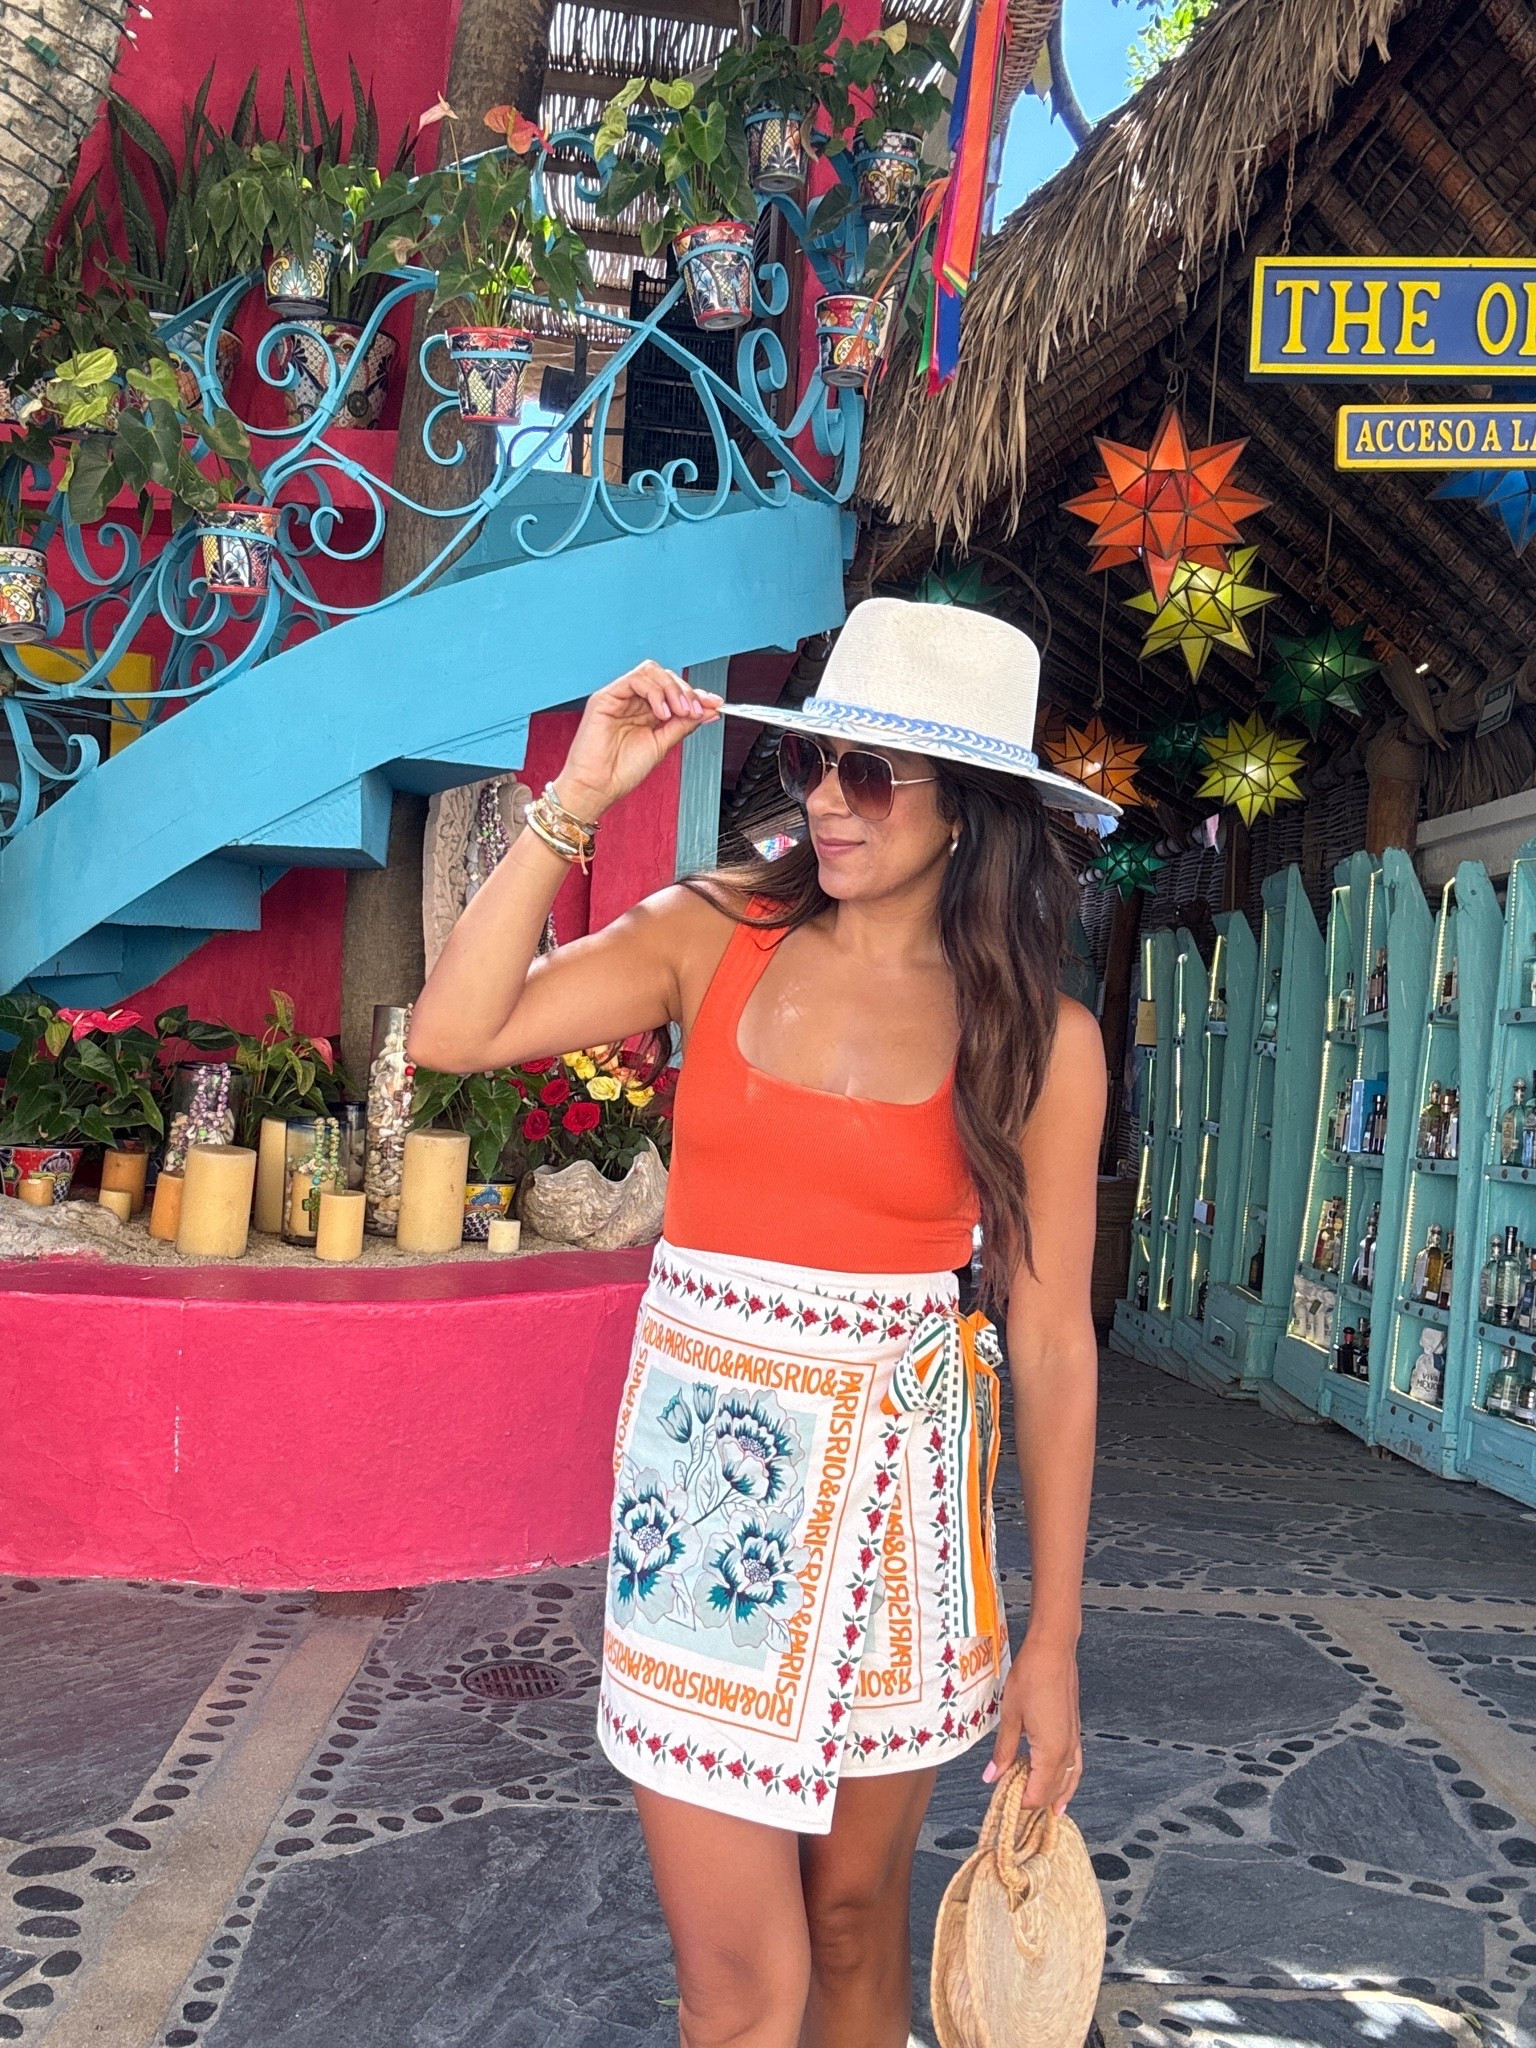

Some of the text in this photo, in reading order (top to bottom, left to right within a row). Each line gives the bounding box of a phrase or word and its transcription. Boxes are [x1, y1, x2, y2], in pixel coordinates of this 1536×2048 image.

[1275, 280, 1441, 355] THE
[1354, 419, 1477, 452] ACCESO
[1480, 419, 1503, 452] A
